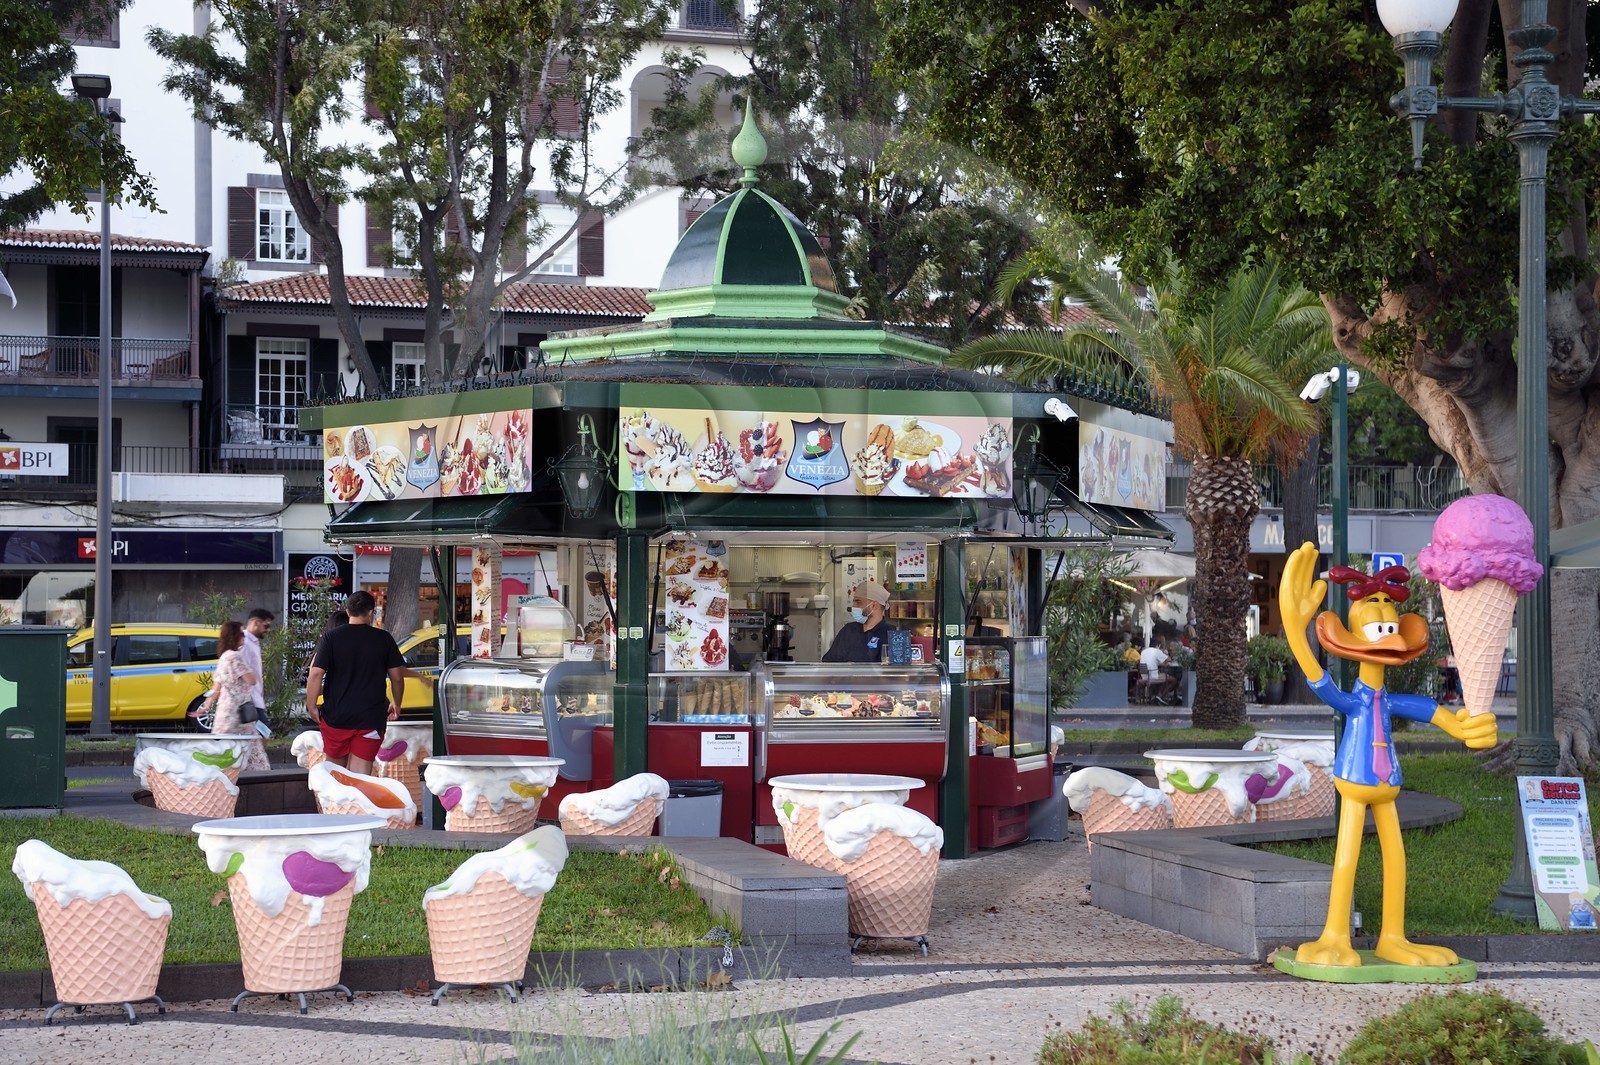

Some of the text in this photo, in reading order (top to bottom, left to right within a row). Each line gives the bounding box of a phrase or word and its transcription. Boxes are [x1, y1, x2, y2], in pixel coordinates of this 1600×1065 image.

[22, 451, 52, 468] BPI
[408, 468, 438, 478] VENEZIA
[789, 464, 846, 476] VENEZIA
[111, 540, 129, 556] PI
[1541, 780, 1580, 792] Carros
